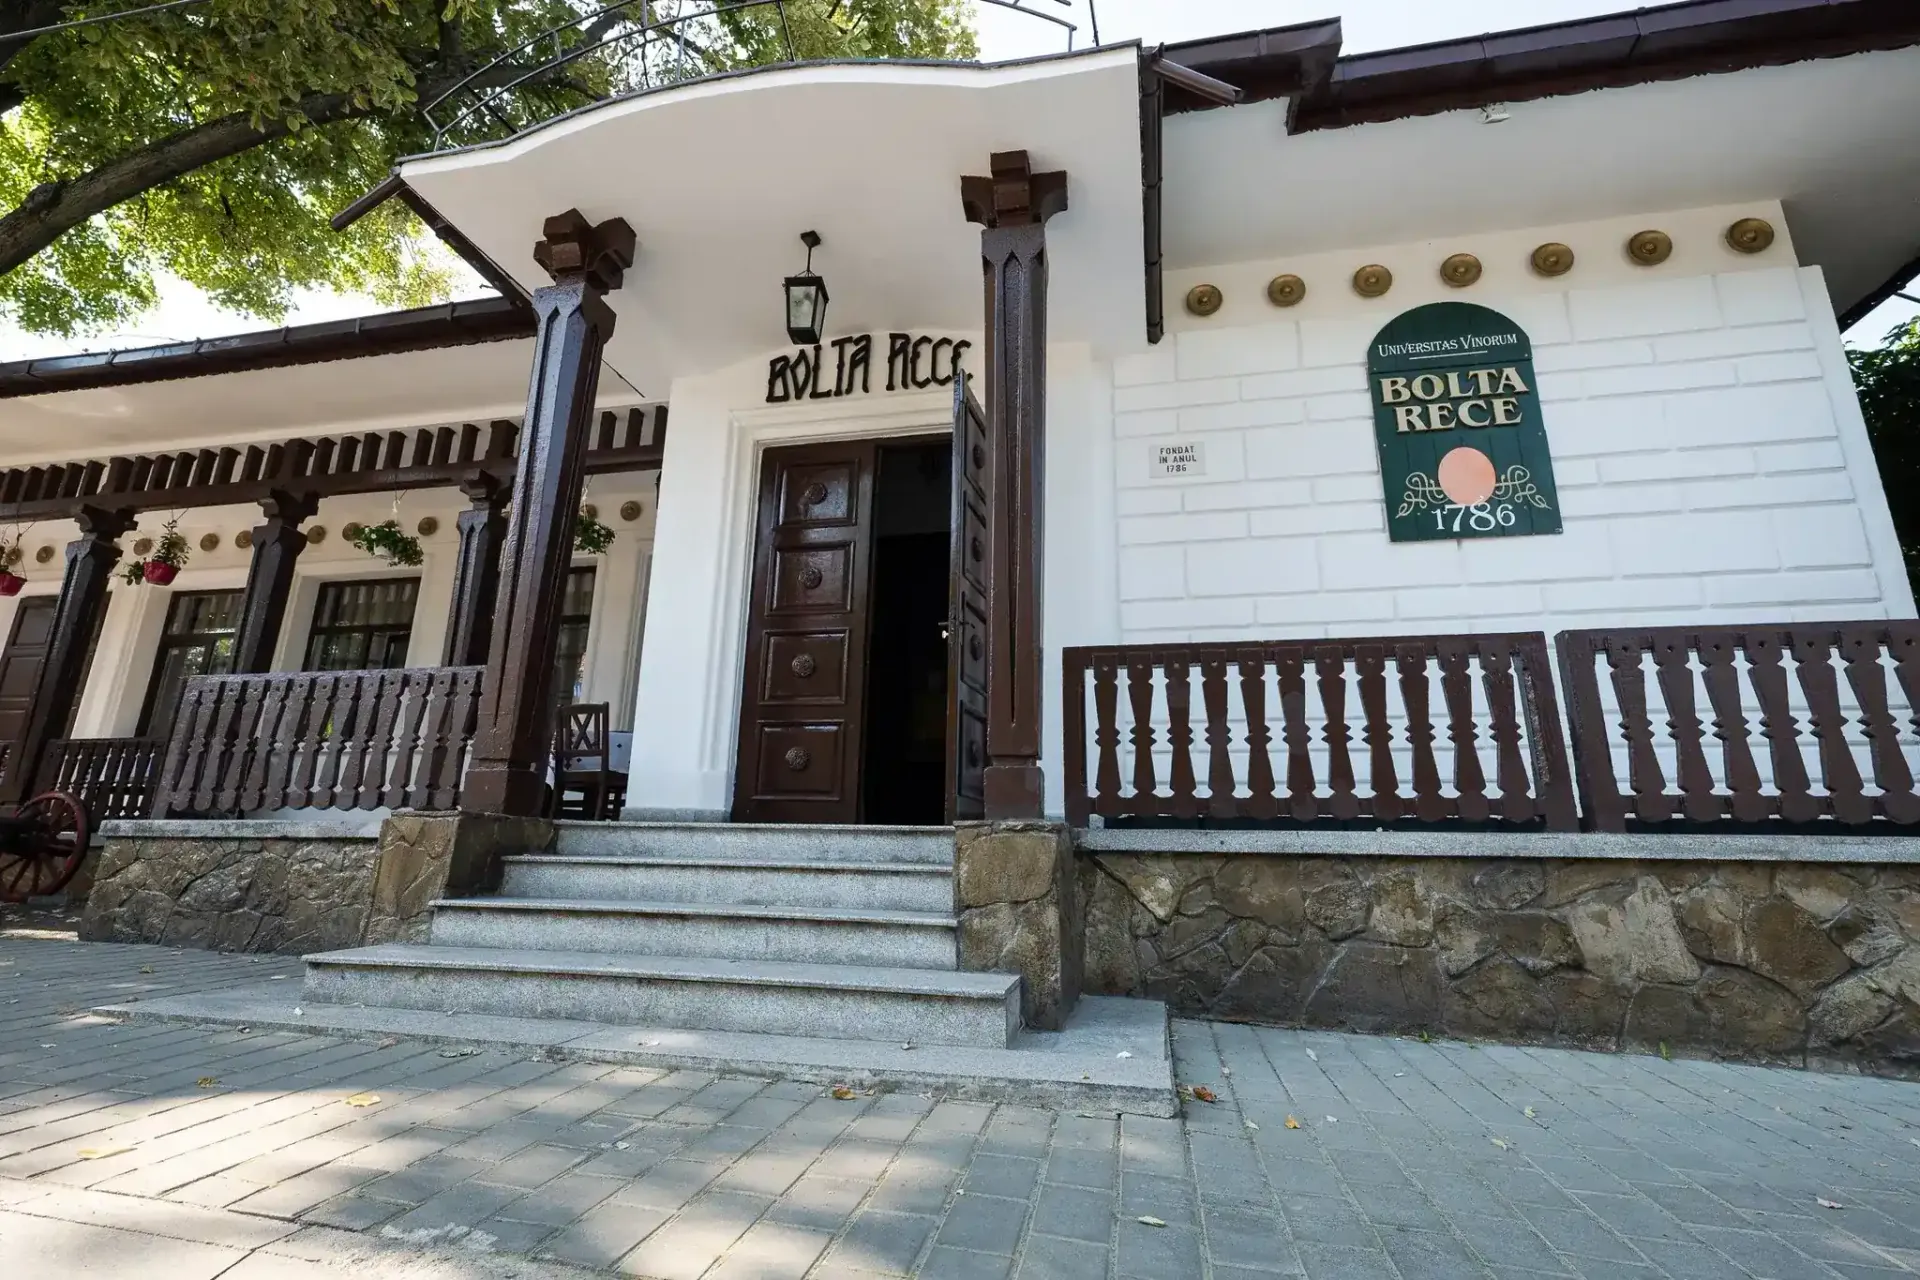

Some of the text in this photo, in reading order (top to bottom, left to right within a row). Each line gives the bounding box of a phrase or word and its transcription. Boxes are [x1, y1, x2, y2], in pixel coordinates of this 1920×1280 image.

[766, 334, 872, 403] BOLTA
[1379, 367, 1530, 404] BOLTA
[1395, 397, 1523, 433] RECE
[1160, 445, 1195, 455] FONDAT
[1173, 454, 1197, 463] ANUL
[1166, 464, 1187, 473] 1786
[1431, 496, 1516, 533] 1786
